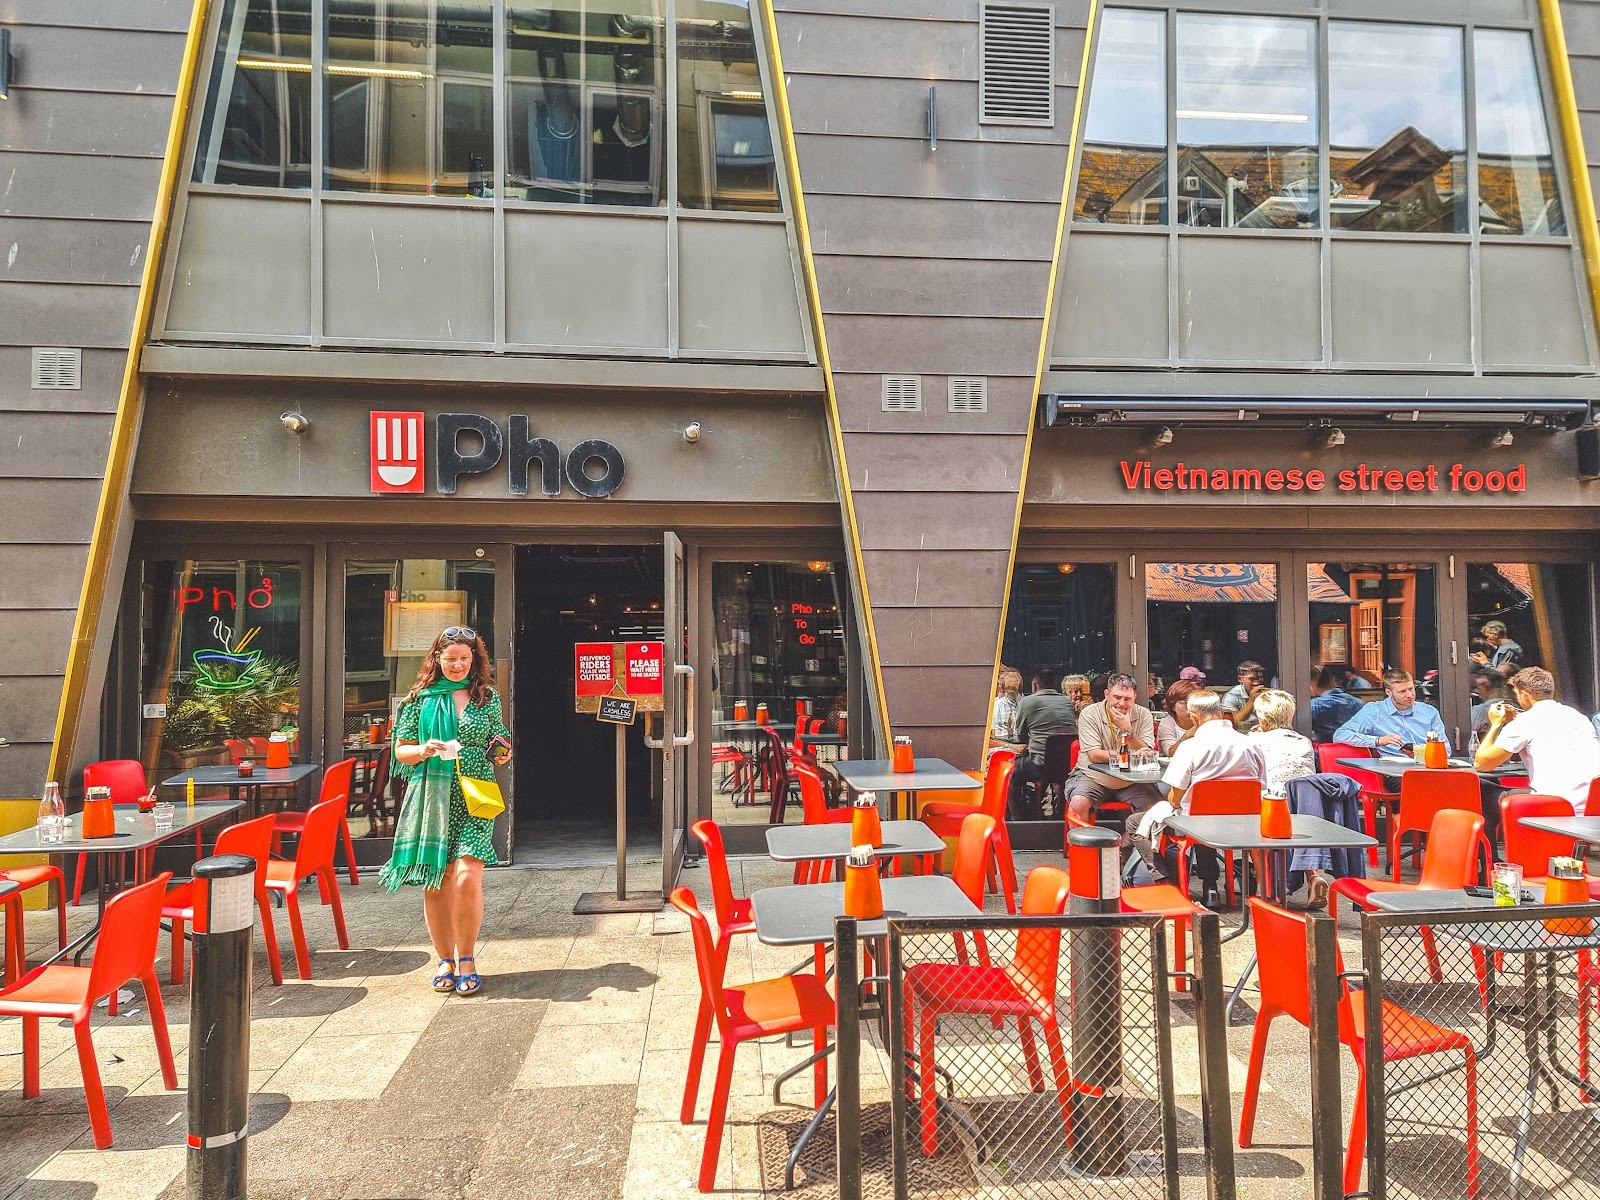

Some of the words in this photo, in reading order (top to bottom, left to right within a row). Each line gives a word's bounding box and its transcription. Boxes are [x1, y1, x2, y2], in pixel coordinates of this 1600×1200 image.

[436, 412, 625, 498] Pho
[1120, 460, 1326, 492] Vietnamese
[1337, 463, 1439, 493] street
[1450, 463, 1528, 494] food
[791, 603, 812, 613] Pho
[794, 618, 807, 629] To
[799, 633, 816, 645] Go
[580, 661, 611, 669] RIDERS
[630, 659, 660, 667] PLEASE
[580, 673, 611, 681] OUTSIDE
[603, 707, 631, 717] CASHLESS
